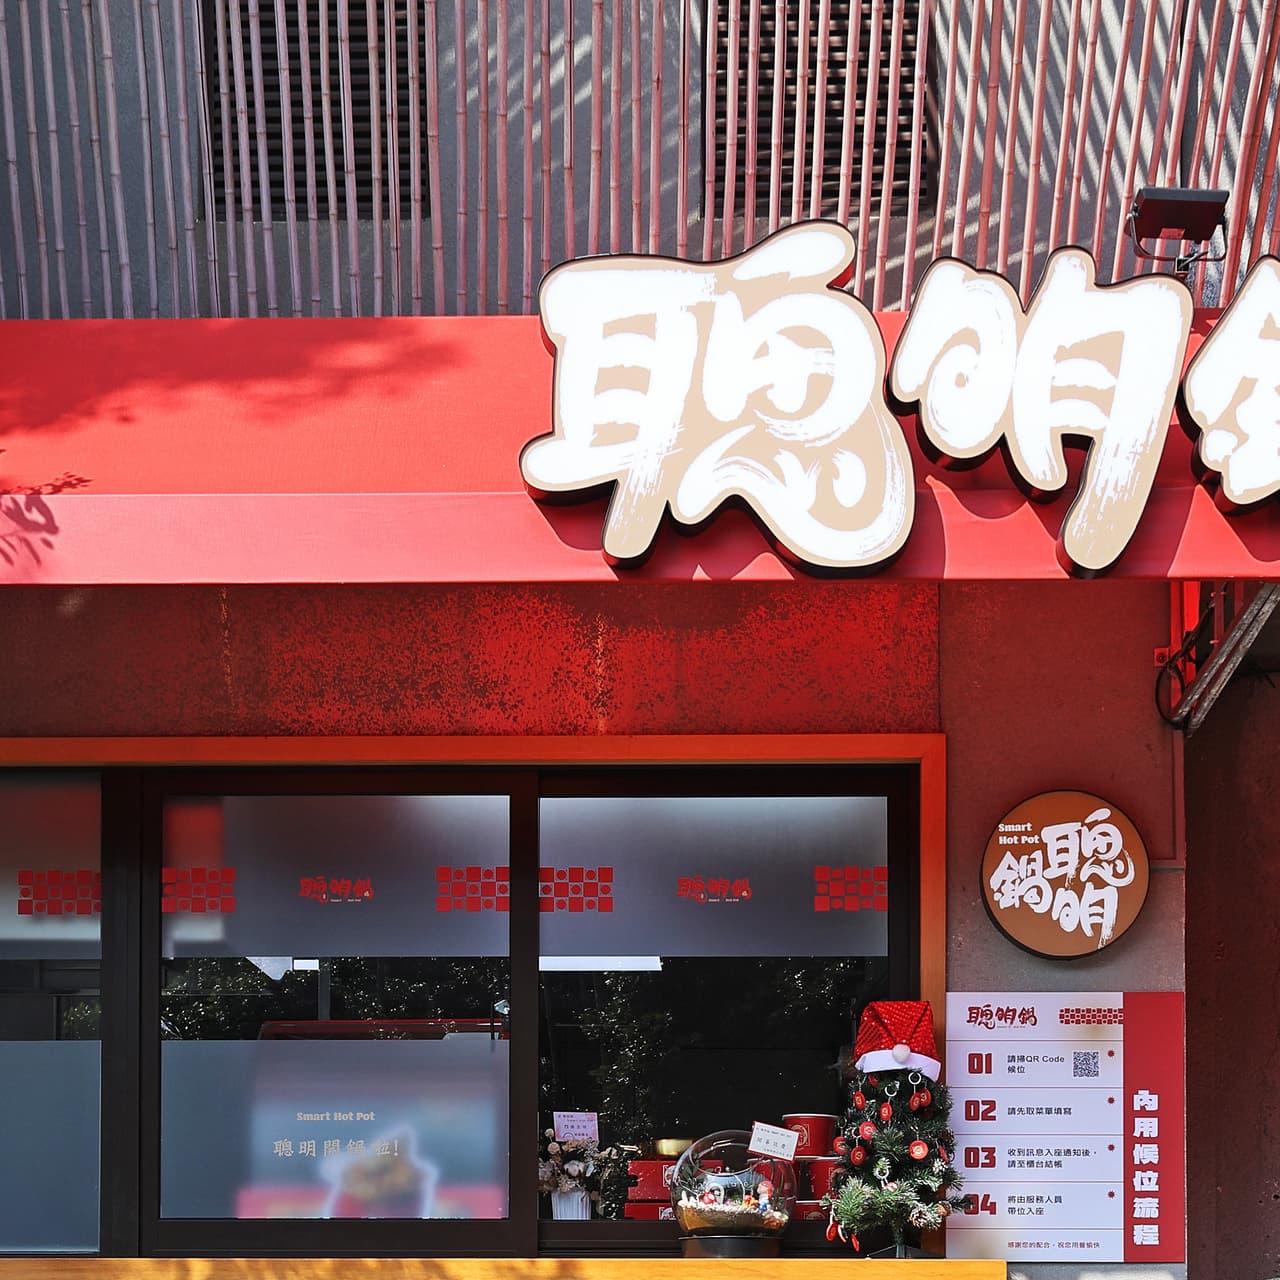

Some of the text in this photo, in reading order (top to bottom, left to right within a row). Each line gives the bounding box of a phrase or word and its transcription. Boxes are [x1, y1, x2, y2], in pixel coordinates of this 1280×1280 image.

[998, 822, 1032, 833] Smart
[999, 835, 1040, 845] Hot Pot
[966, 1004, 1037, 1030] 聰明鍋
[968, 1053, 993, 1075] 01
[1042, 1055, 1065, 1063] Code
[1007, 1065, 1026, 1074] 候位
[296, 1111, 376, 1121] Smart Hot Pot
[964, 1100, 997, 1121] 02
[964, 1147, 996, 1168] 03
[963, 1194, 997, 1215] 04
